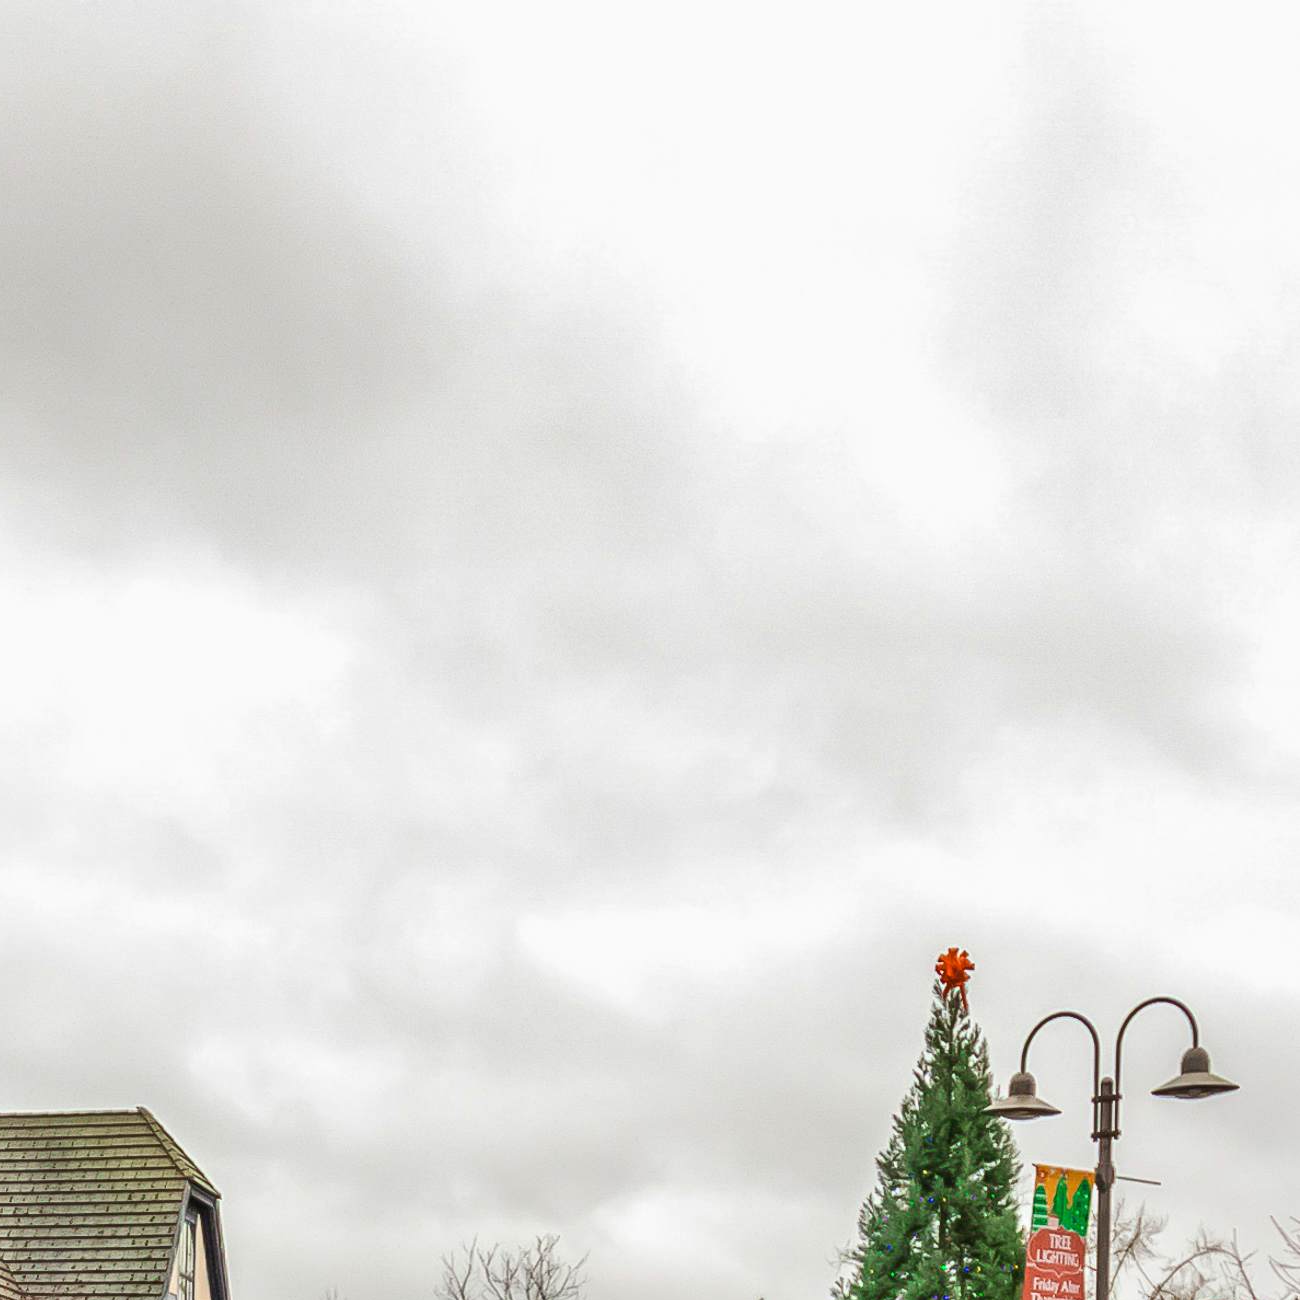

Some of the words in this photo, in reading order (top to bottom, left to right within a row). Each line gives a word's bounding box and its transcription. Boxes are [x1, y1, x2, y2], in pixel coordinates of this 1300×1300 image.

[1049, 1233, 1071, 1250] TREE
[1036, 1249, 1079, 1267] LIGHTING
[1033, 1277, 1060, 1294] Friday
